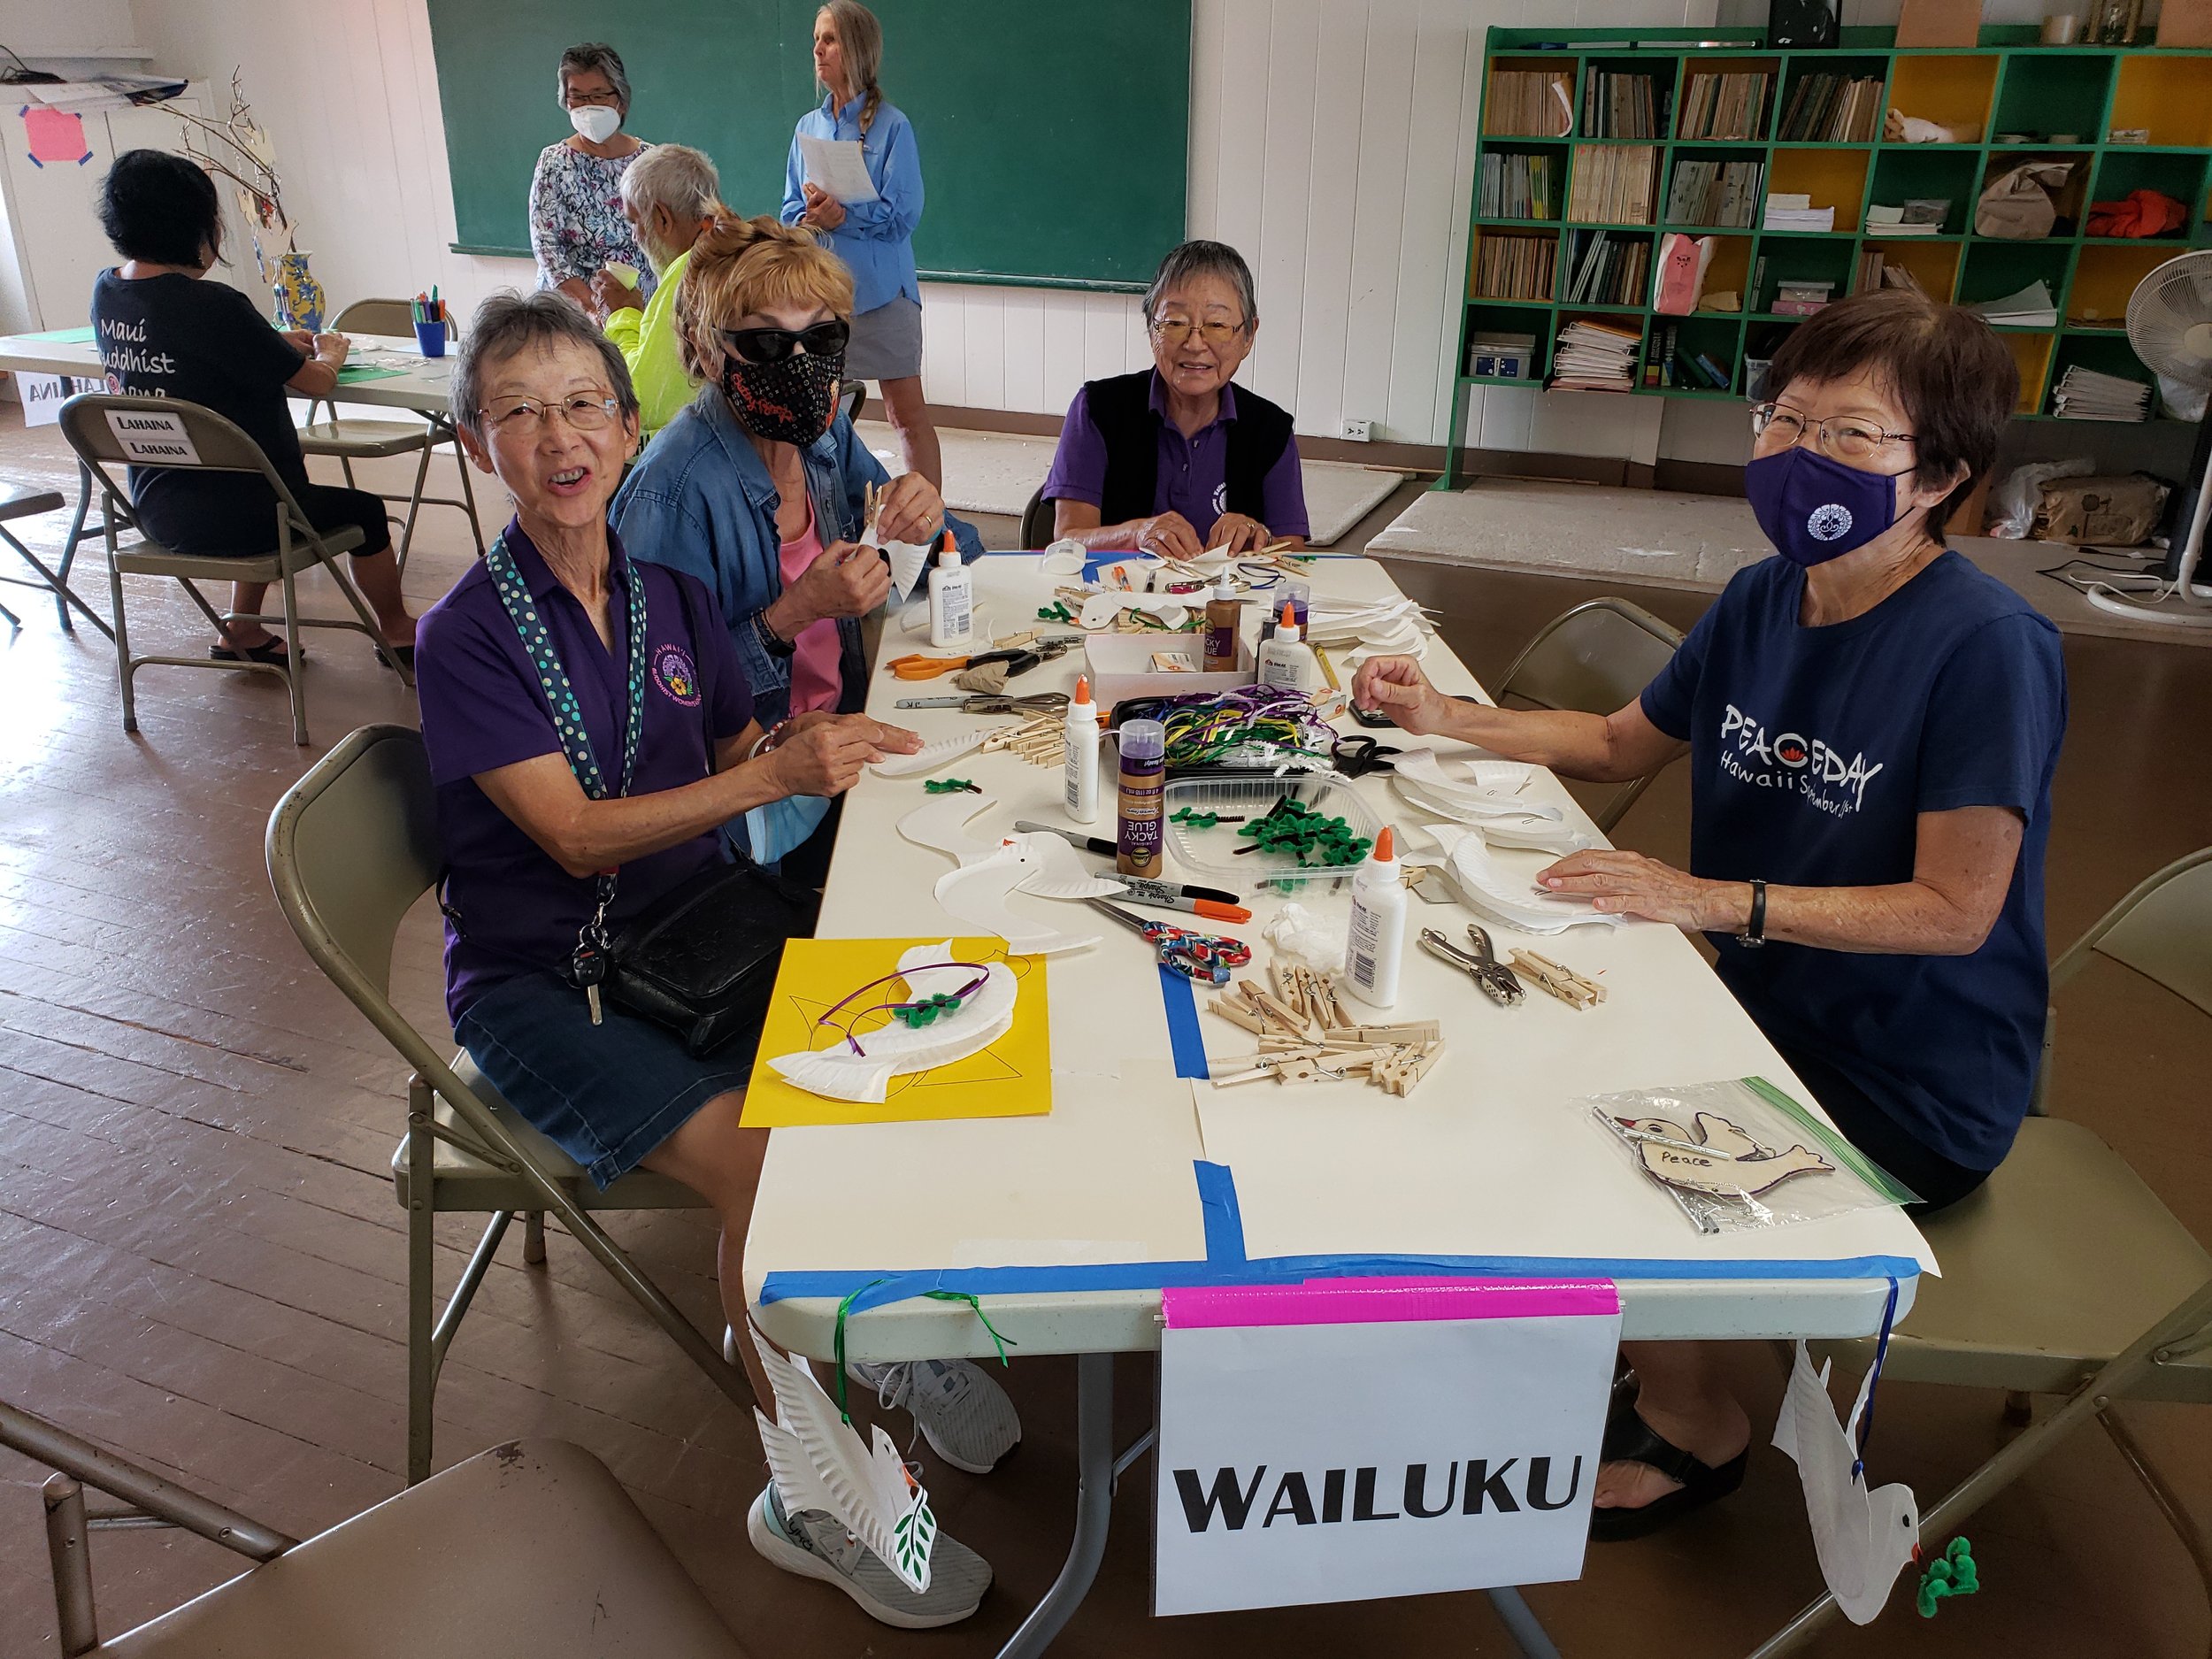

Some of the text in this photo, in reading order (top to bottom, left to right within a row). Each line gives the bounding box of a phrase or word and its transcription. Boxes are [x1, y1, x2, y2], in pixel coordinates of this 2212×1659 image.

[101, 319, 147, 342] Maui
[101, 345, 176, 374] uddhist
[116, 417, 175, 431] LAHAINA
[129, 442, 188, 456] LAHAINA
[1204, 638, 1221, 649] CKY
[1204, 647, 1217, 656] LUE
[652, 667, 673, 698] BUDDHIST
[1720, 749, 1793, 789] Hawaii
[1127, 820, 1157, 832] GLUE
[1124, 830, 1159, 841] TACKY
[1662, 1151, 1713, 1167] Peace
[1171, 1455, 1583, 1533] WAILUKU
